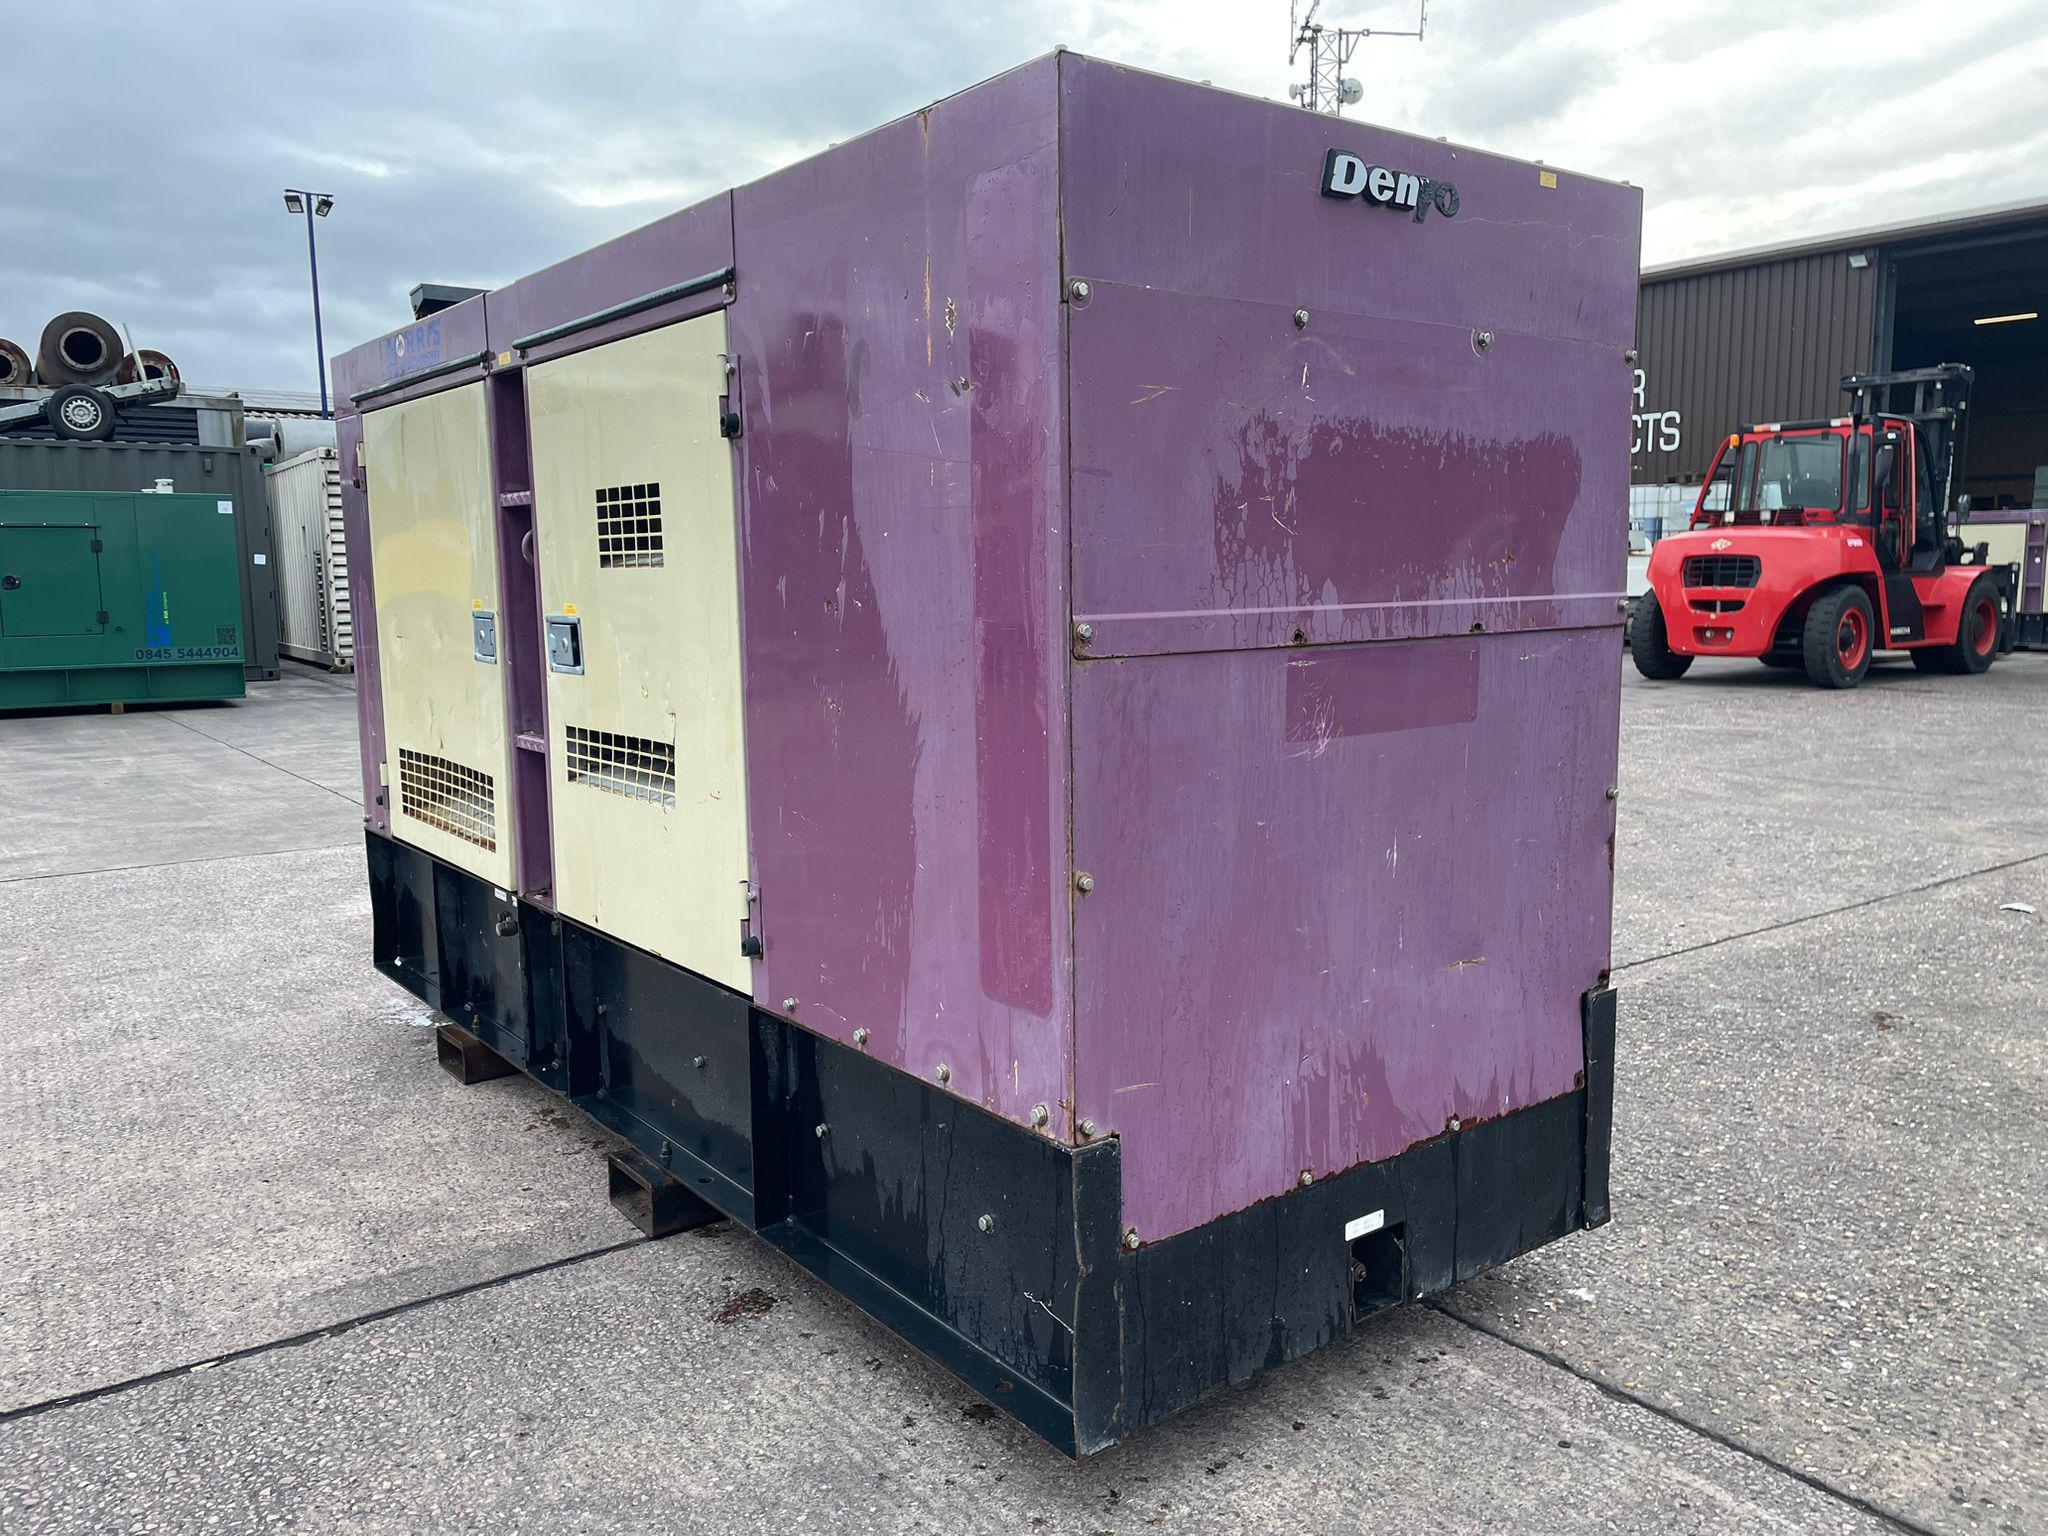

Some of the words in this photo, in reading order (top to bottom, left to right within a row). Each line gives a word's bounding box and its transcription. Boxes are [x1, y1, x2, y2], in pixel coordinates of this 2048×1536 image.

[1322, 149, 1460, 223] Denyo
[135, 648, 172, 660] 0845
[176, 646, 239, 659] 5444904
